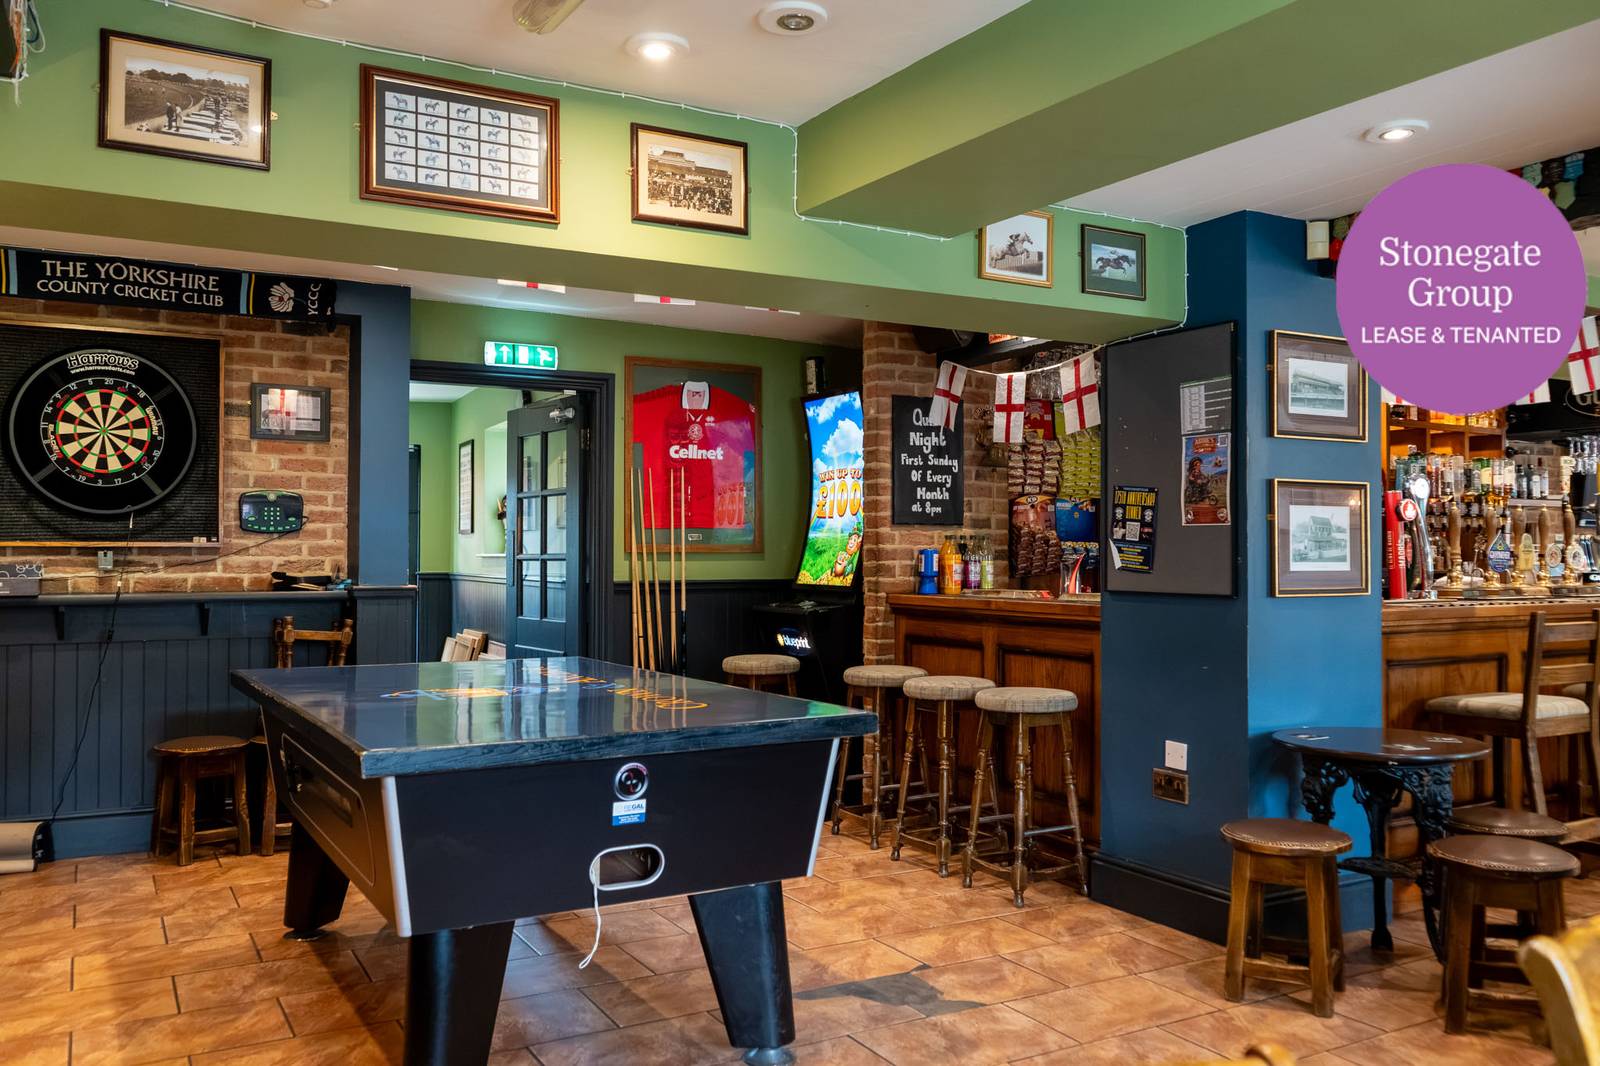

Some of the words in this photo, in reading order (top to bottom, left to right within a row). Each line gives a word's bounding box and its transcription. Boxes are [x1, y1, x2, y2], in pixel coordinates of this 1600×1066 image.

[41, 260, 88, 278] THE
[95, 262, 220, 291] YORKSHIRE
[37, 279, 109, 295] COUNTY
[113, 284, 179, 302] CRICKET
[182, 292, 224, 307] CLUB
[307, 283, 321, 315] YCCC
[66, 353, 139, 370] Harrows
[909, 432, 947, 454] Night
[669, 445, 724, 460] Cellnet
[901, 453, 924, 466] First
[928, 454, 959, 472] Sunday
[819, 470, 835, 482] WIN
[836, 468, 848, 479] UP
[850, 468, 862, 480] TO
[911, 470, 922, 482] Of
[926, 470, 952, 488] Every
[816, 480, 861, 518] £100
[917, 487, 950, 500] Month
[911, 502, 923, 512] at
[925, 501, 942, 516] 8pm
[782, 634, 811, 650] blueprint
